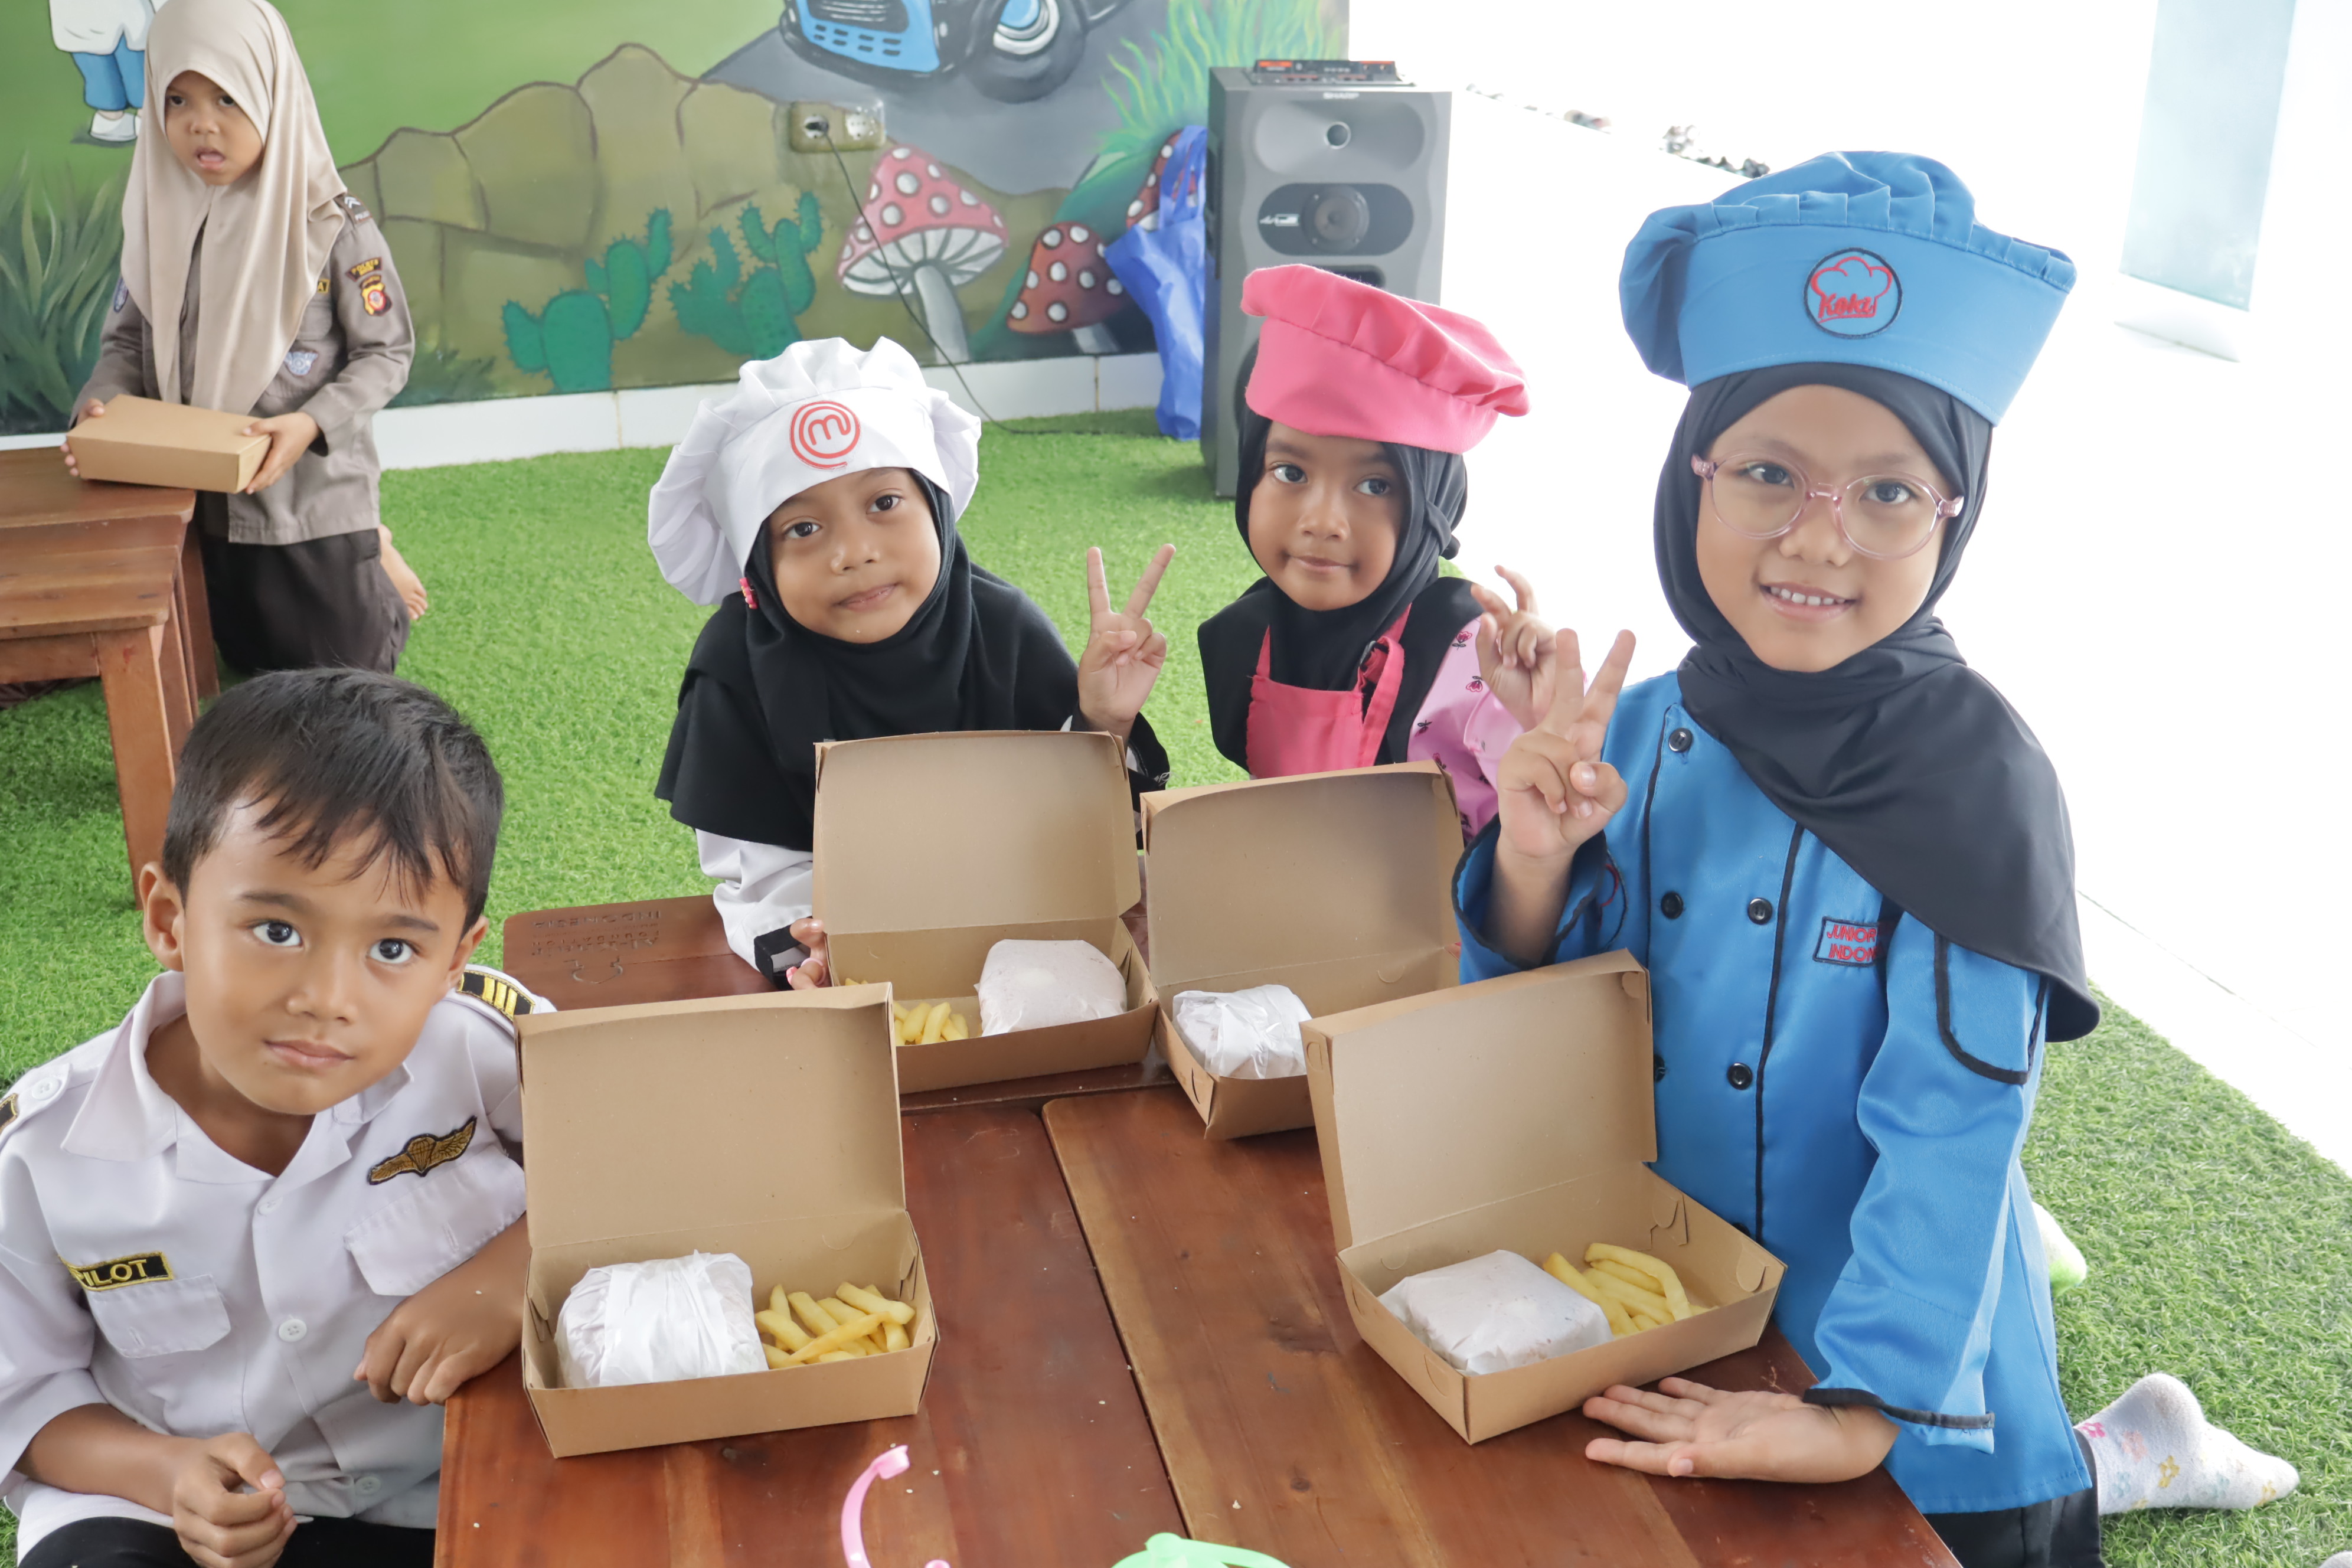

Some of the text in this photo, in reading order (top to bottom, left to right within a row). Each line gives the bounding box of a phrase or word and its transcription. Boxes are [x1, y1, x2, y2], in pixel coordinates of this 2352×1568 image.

[533, 910, 661, 928] INDONESIA
[1827, 925, 1877, 942] JUNIOR
[72, 1259, 147, 1286] ILOT
